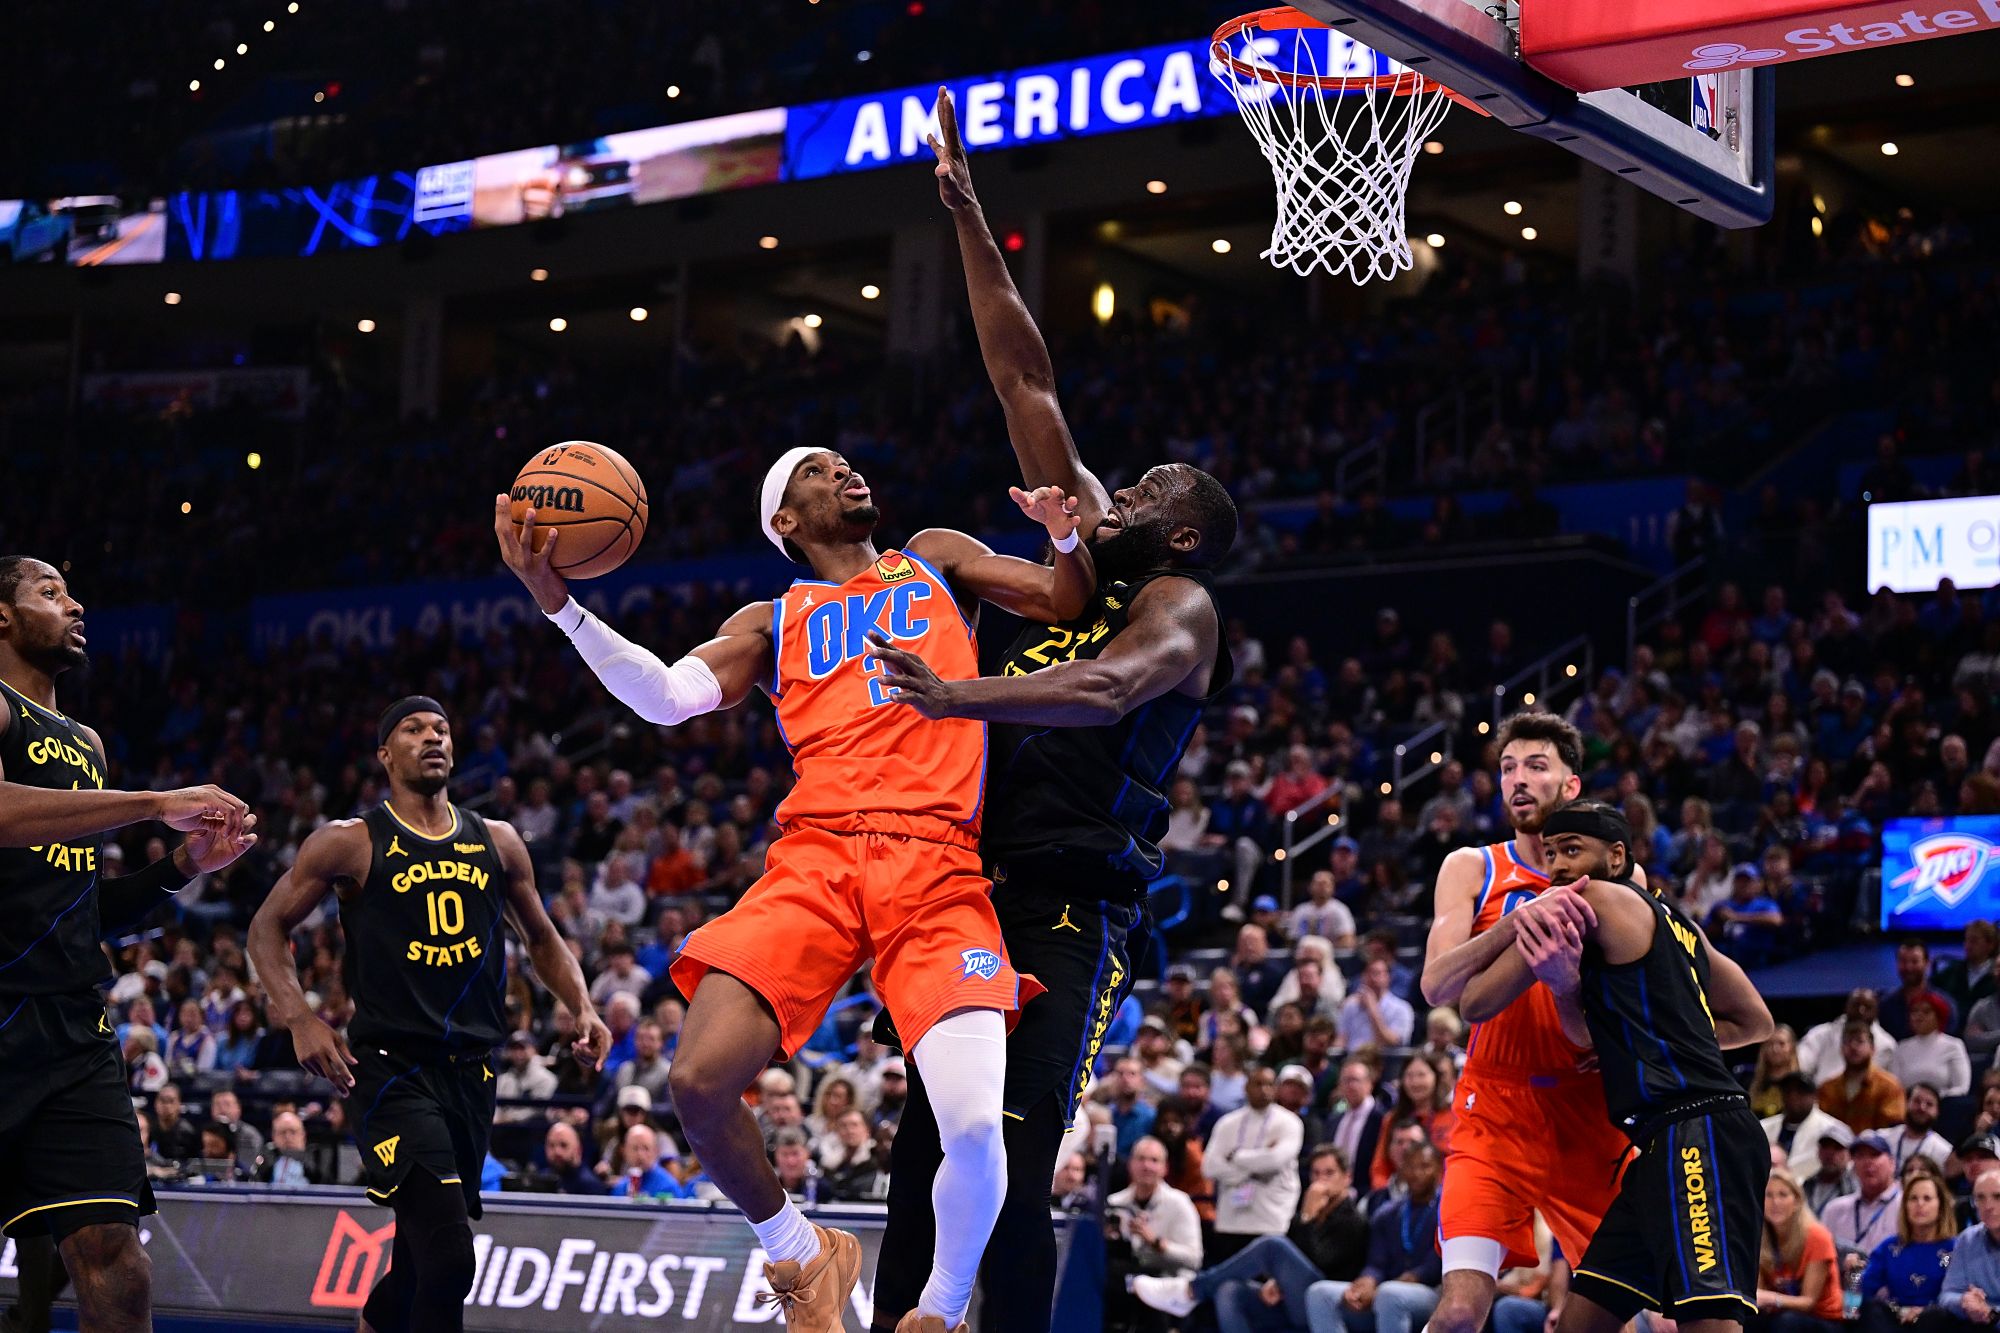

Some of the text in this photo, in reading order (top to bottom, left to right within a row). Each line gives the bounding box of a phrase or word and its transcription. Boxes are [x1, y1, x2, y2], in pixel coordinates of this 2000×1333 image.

[1784, 10, 1978, 53] State
[511, 484, 585, 513] Wilson
[807, 581, 932, 680] OKC
[27, 736, 104, 791] GOLDEN
[29, 842, 96, 872] TATE
[391, 860, 489, 893] GOLDEN
[426, 890, 465, 936] 10
[406, 935, 482, 967] STATE
[964, 954, 994, 975] OKC
[1681, 1146, 1717, 1273] WARRIORS
